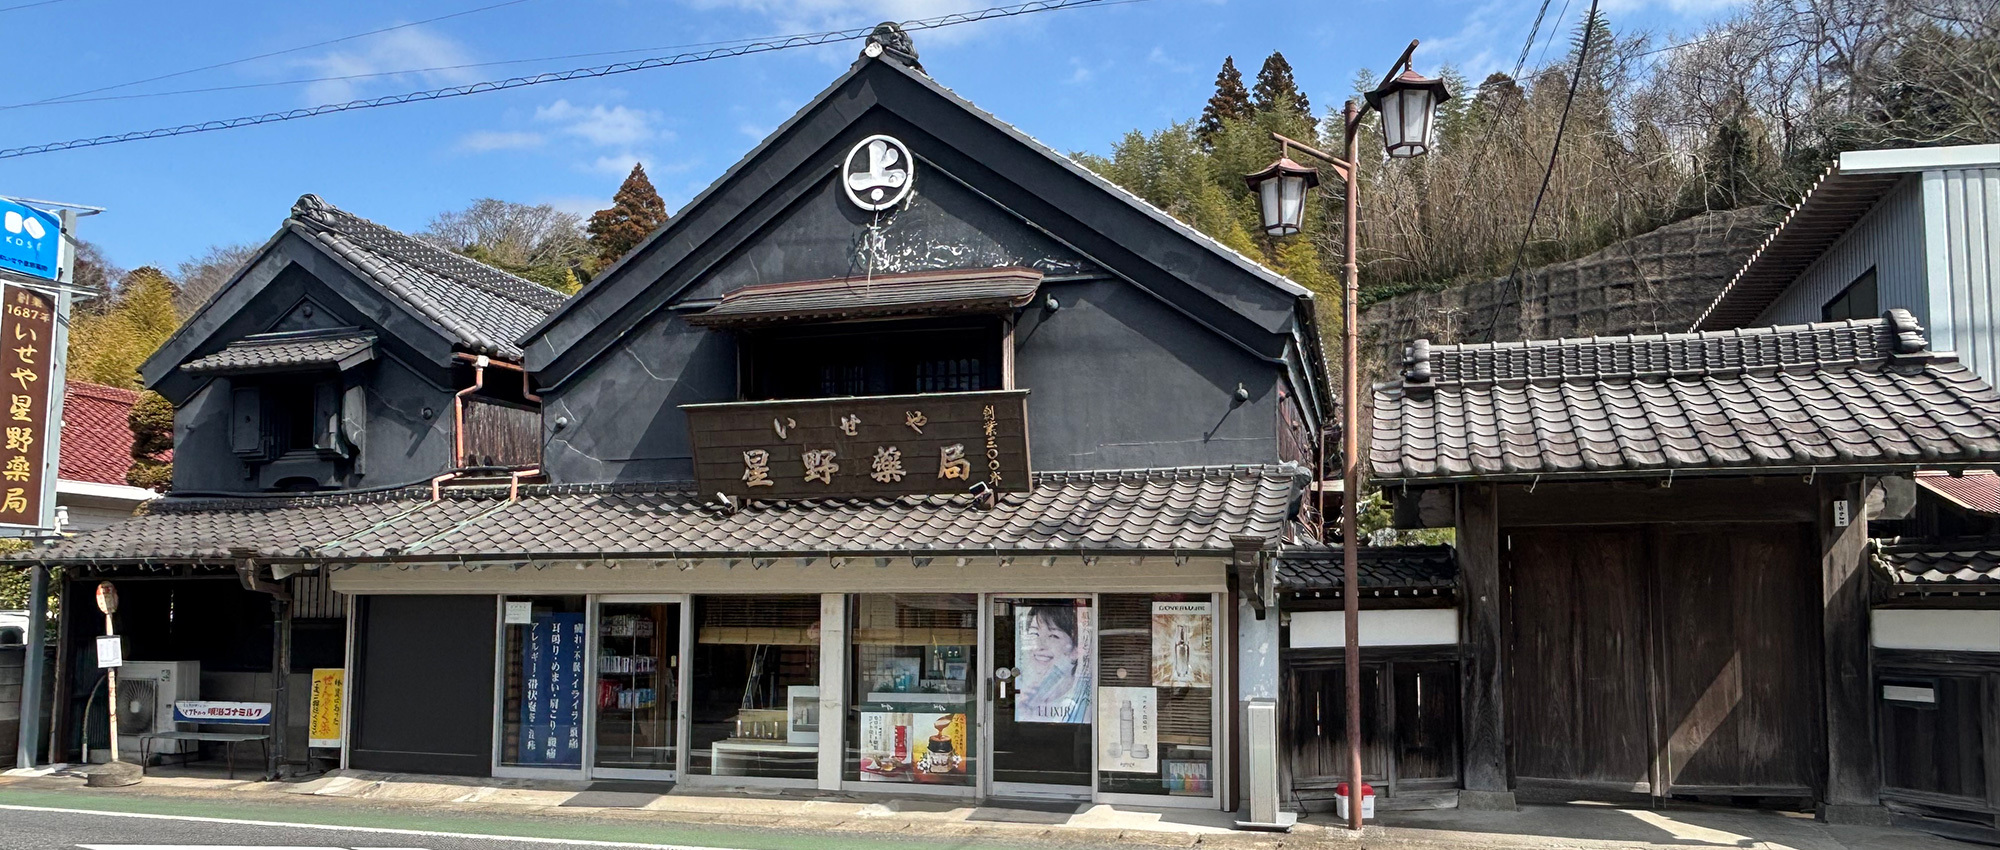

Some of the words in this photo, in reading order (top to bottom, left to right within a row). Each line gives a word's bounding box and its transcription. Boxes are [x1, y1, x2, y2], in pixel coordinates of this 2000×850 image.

[7, 304, 50, 322] 1687年
[0, 322, 38, 515] いせや星野薬局
[774, 410, 928, 439] いせや
